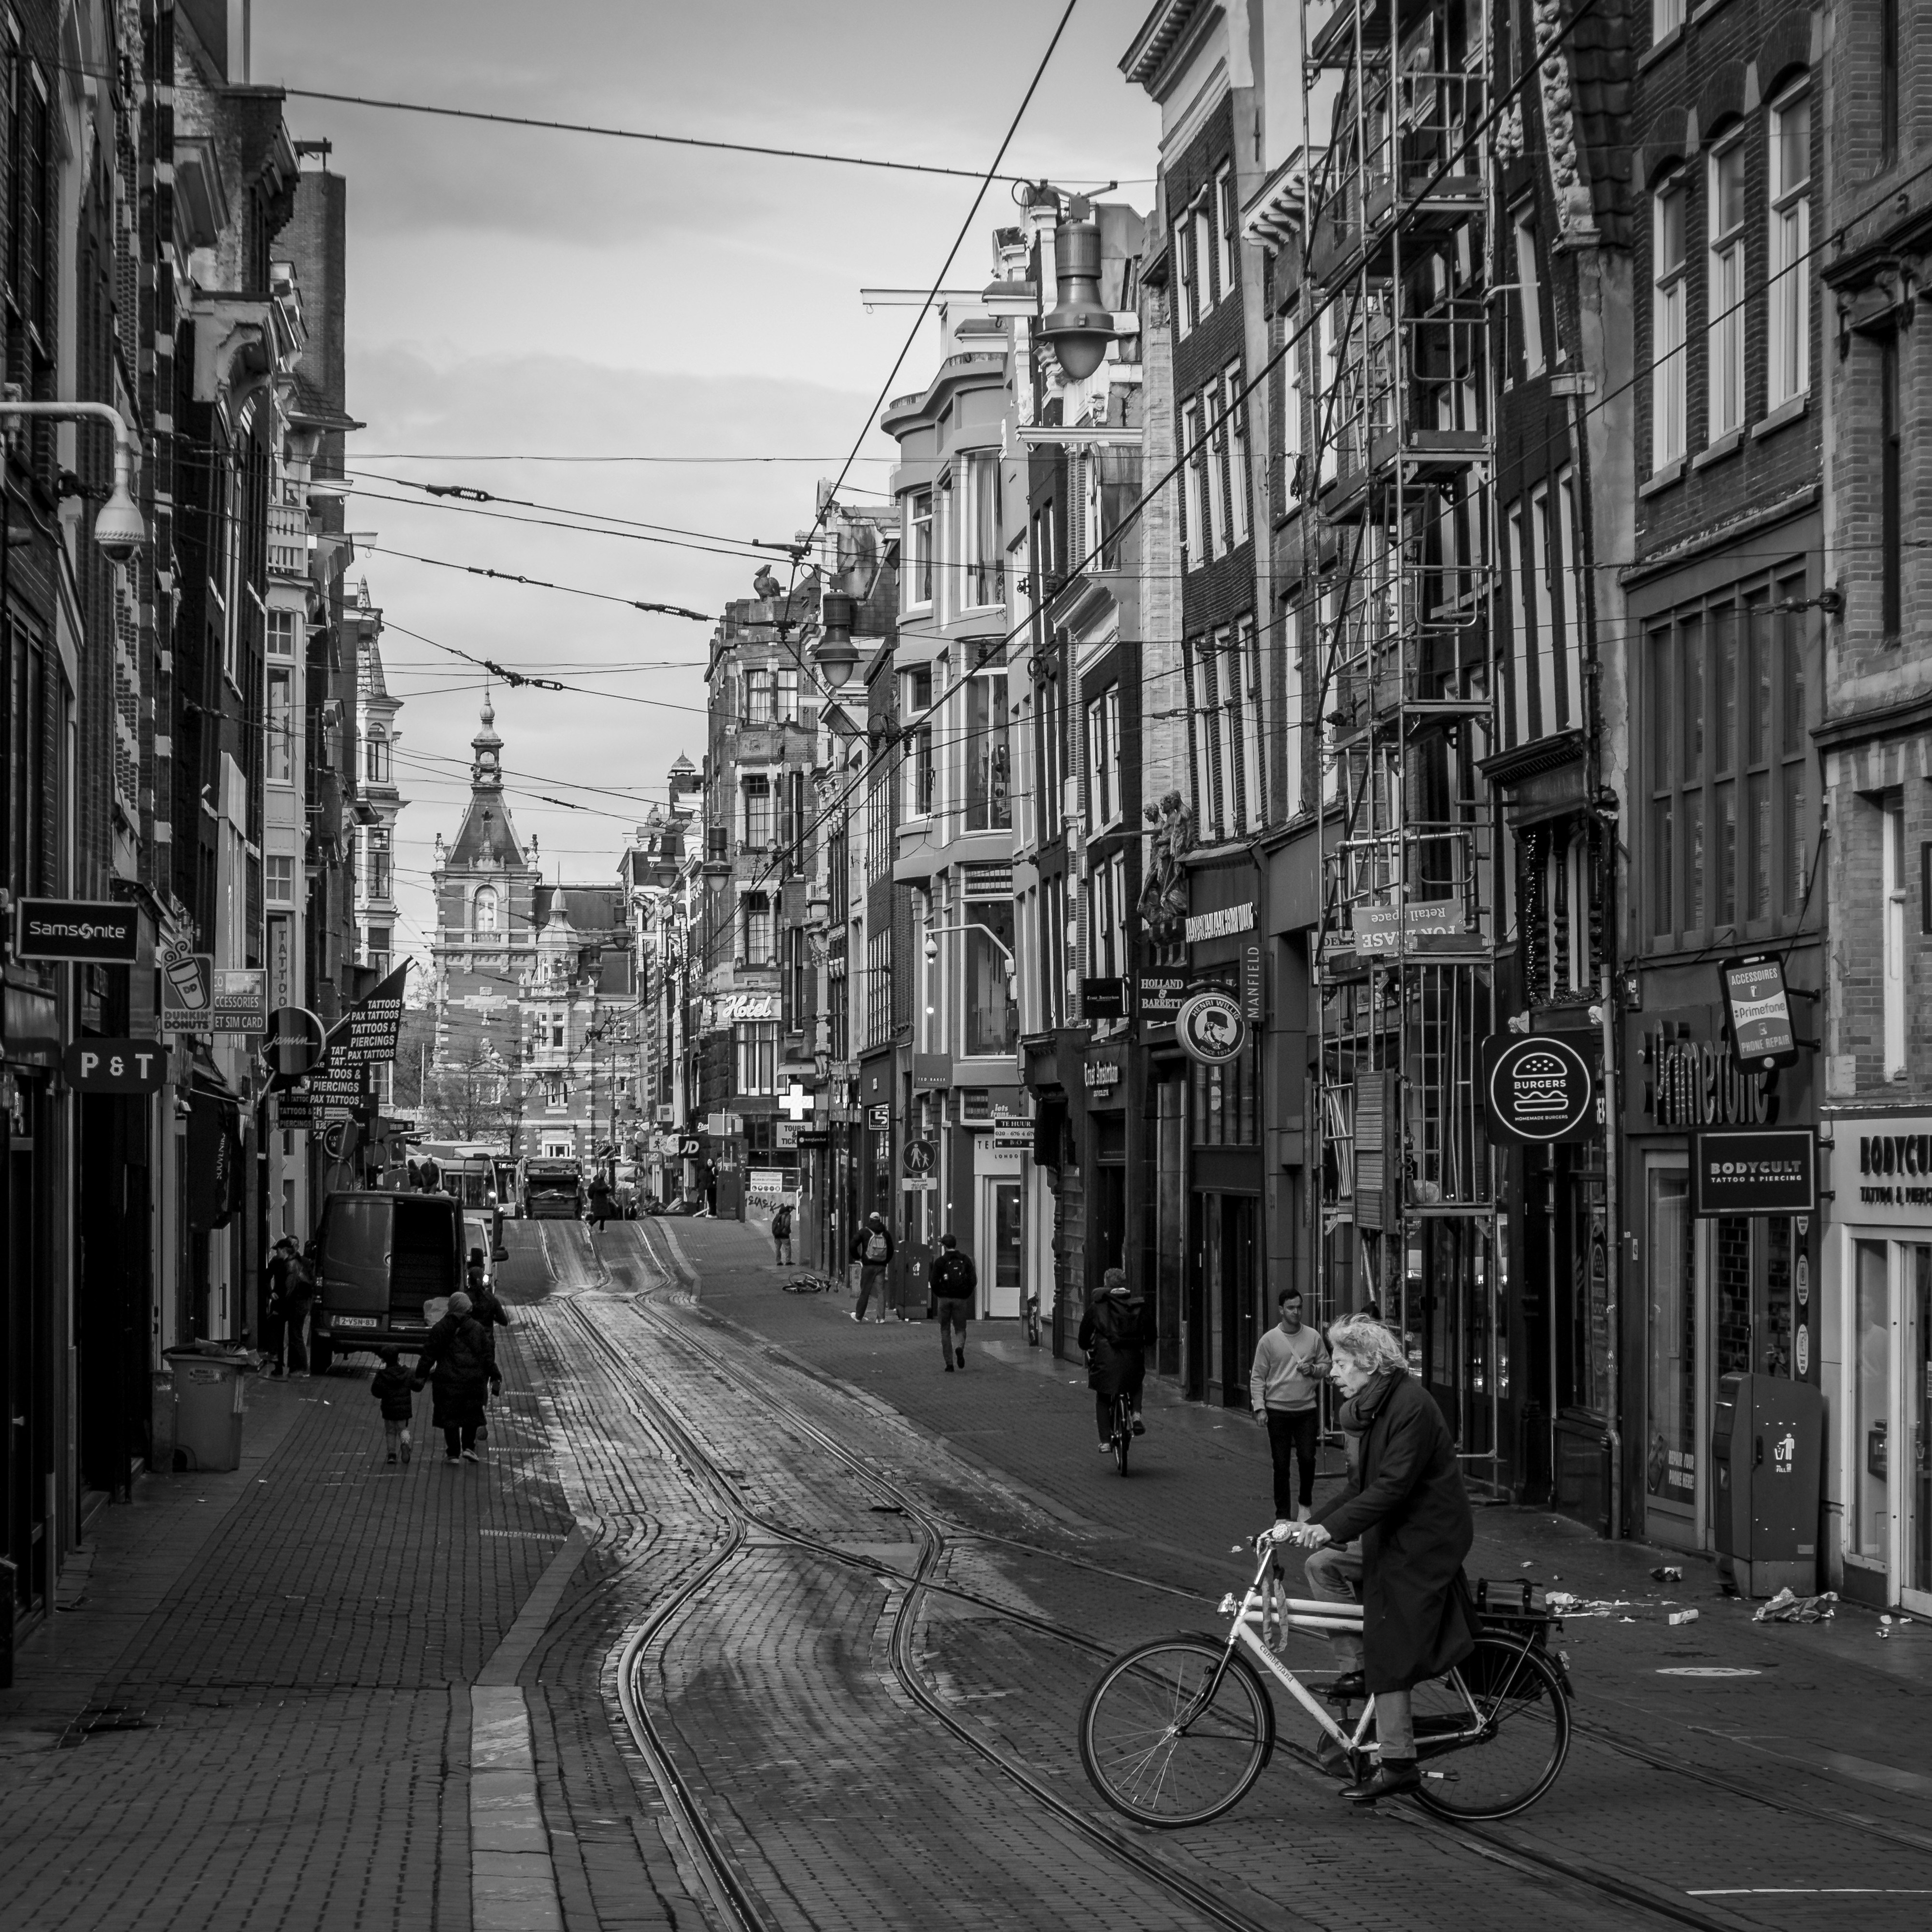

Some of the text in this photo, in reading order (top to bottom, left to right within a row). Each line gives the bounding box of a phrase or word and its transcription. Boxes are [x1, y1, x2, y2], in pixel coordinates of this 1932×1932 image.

[1371, 907, 1446, 923] Retail pace
[29, 921, 126, 938] Samsonite
[1362, 930, 1416, 948] LASE
[1247, 947, 1259, 1018] MANFIELD
[1731, 967, 1778, 986] ACCESSOIRES
[1141, 979, 1183, 989] HOLLAND
[1159, 989, 1167, 999] &
[214, 996, 259, 1008] CCESSORIES
[367, 999, 400, 1009] TATTOOS
[722, 994, 772, 1018] Hotel
[1141, 998, 1183, 1009] BARRETT
[351, 1010, 399, 1021] PAX TATTOOS
[1191, 999, 1241, 1020] HENRI WILLIG
[164, 1020, 210, 1030] DONUTS
[215, 1016, 263, 1028] ET SIM CARD
[351, 1022, 397, 1035] TATTOOS &
[350, 1035, 395, 1048] PIERCINGS
[1741, 1034, 1790, 1052] PHONE REPAIR
[347, 1048, 395, 1060] PAX TATTOOS
[1199, 1045, 1231, 1056] SINCE 1974
[81, 1052, 154, 1079] P & T
[354, 1069, 361, 1080] &
[313, 1081, 359, 1093] PIERCINGS
[1514, 1079, 1567, 1090] BURGERS
[310, 1094, 360, 1105] PAX TATTOOS
[279, 1107, 306, 1115] TATTOOS
[307, 1107, 312, 1115] &
[279, 1120, 312, 1128] PIERCINGS
[681, 1140, 699, 1153] JD
[1711, 1160, 1802, 1174] BODYCULT
[1759, 1174, 1802, 1182] PIERCING
